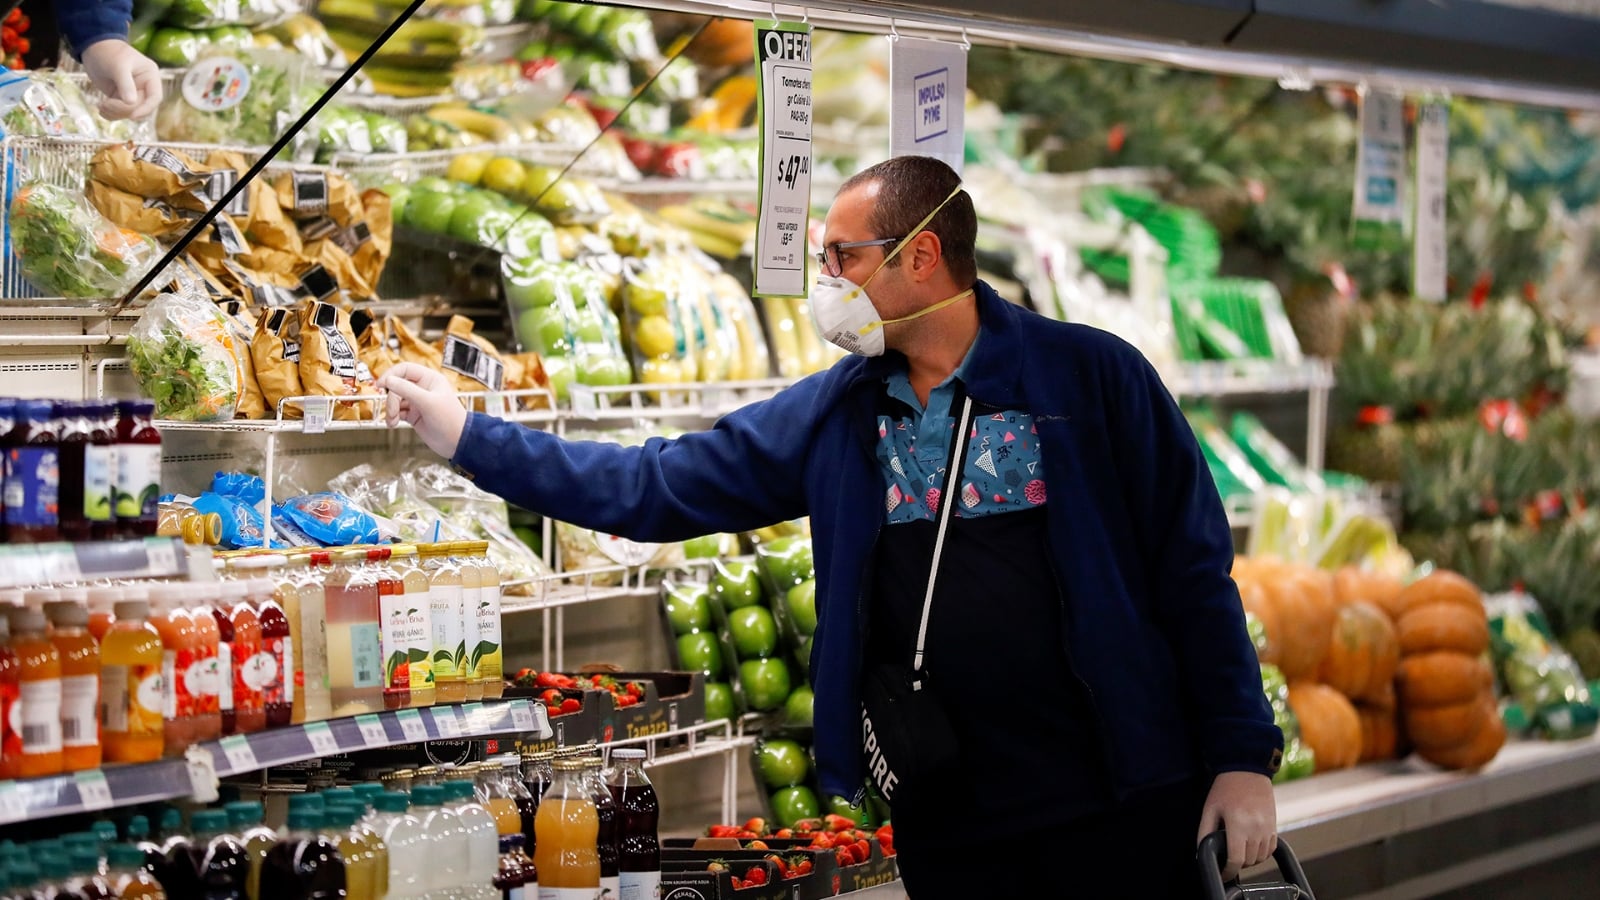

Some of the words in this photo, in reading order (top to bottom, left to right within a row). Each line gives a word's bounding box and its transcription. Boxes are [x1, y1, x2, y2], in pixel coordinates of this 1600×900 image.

[764, 31, 812, 62] OFER
[782, 76, 801, 89] Tomates
[918, 82, 945, 106] IMPULSO
[924, 104, 940, 126] PYME
[778, 158, 784, 184] $
[627, 721, 668, 738] Tamara
[853, 872, 893, 890] Tamara
